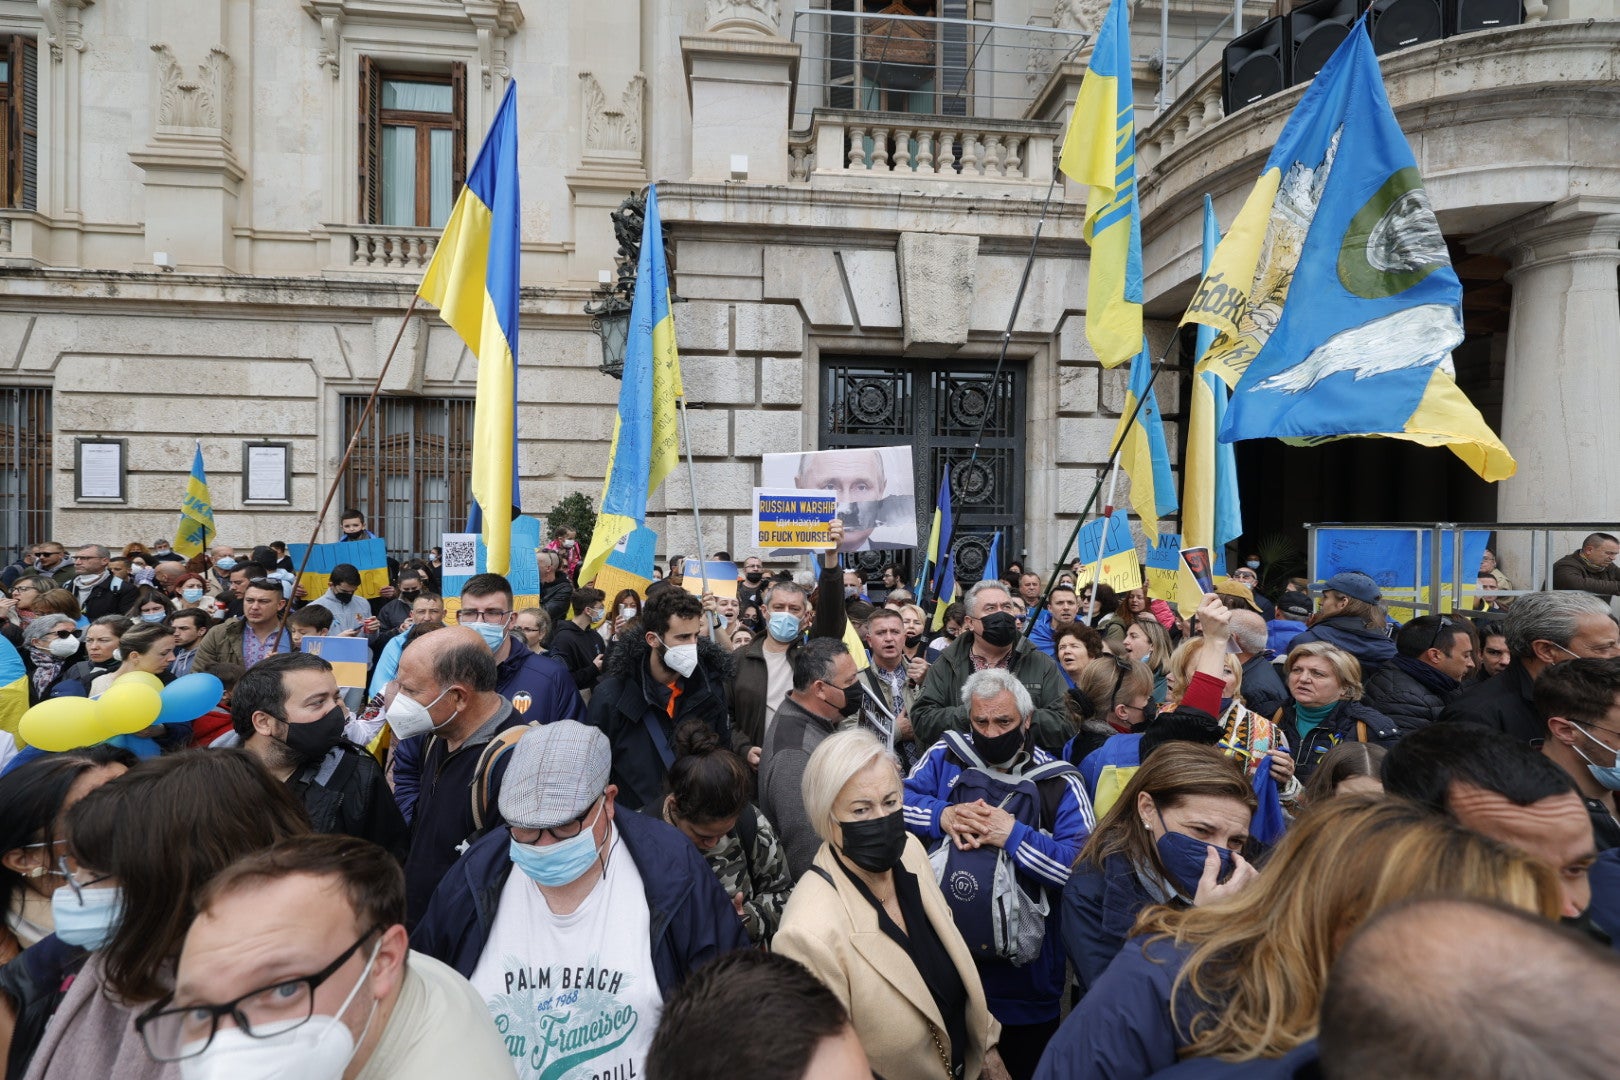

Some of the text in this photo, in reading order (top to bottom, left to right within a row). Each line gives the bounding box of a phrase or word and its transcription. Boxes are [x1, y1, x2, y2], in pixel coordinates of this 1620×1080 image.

[760, 500, 836, 513] RUSSIAN WARSHIP
[759, 531, 832, 542] GO FUCK YOURSEL
[1084, 515, 1120, 558] HELP
[1155, 570, 1179, 580] UKRA
[959, 882, 969, 891] 07
[504, 967, 623, 995] PALM BEACH
[537, 989, 579, 1012] est. 1968
[531, 1004, 638, 1070] Francisco
[592, 1058, 636, 1080] RILL
